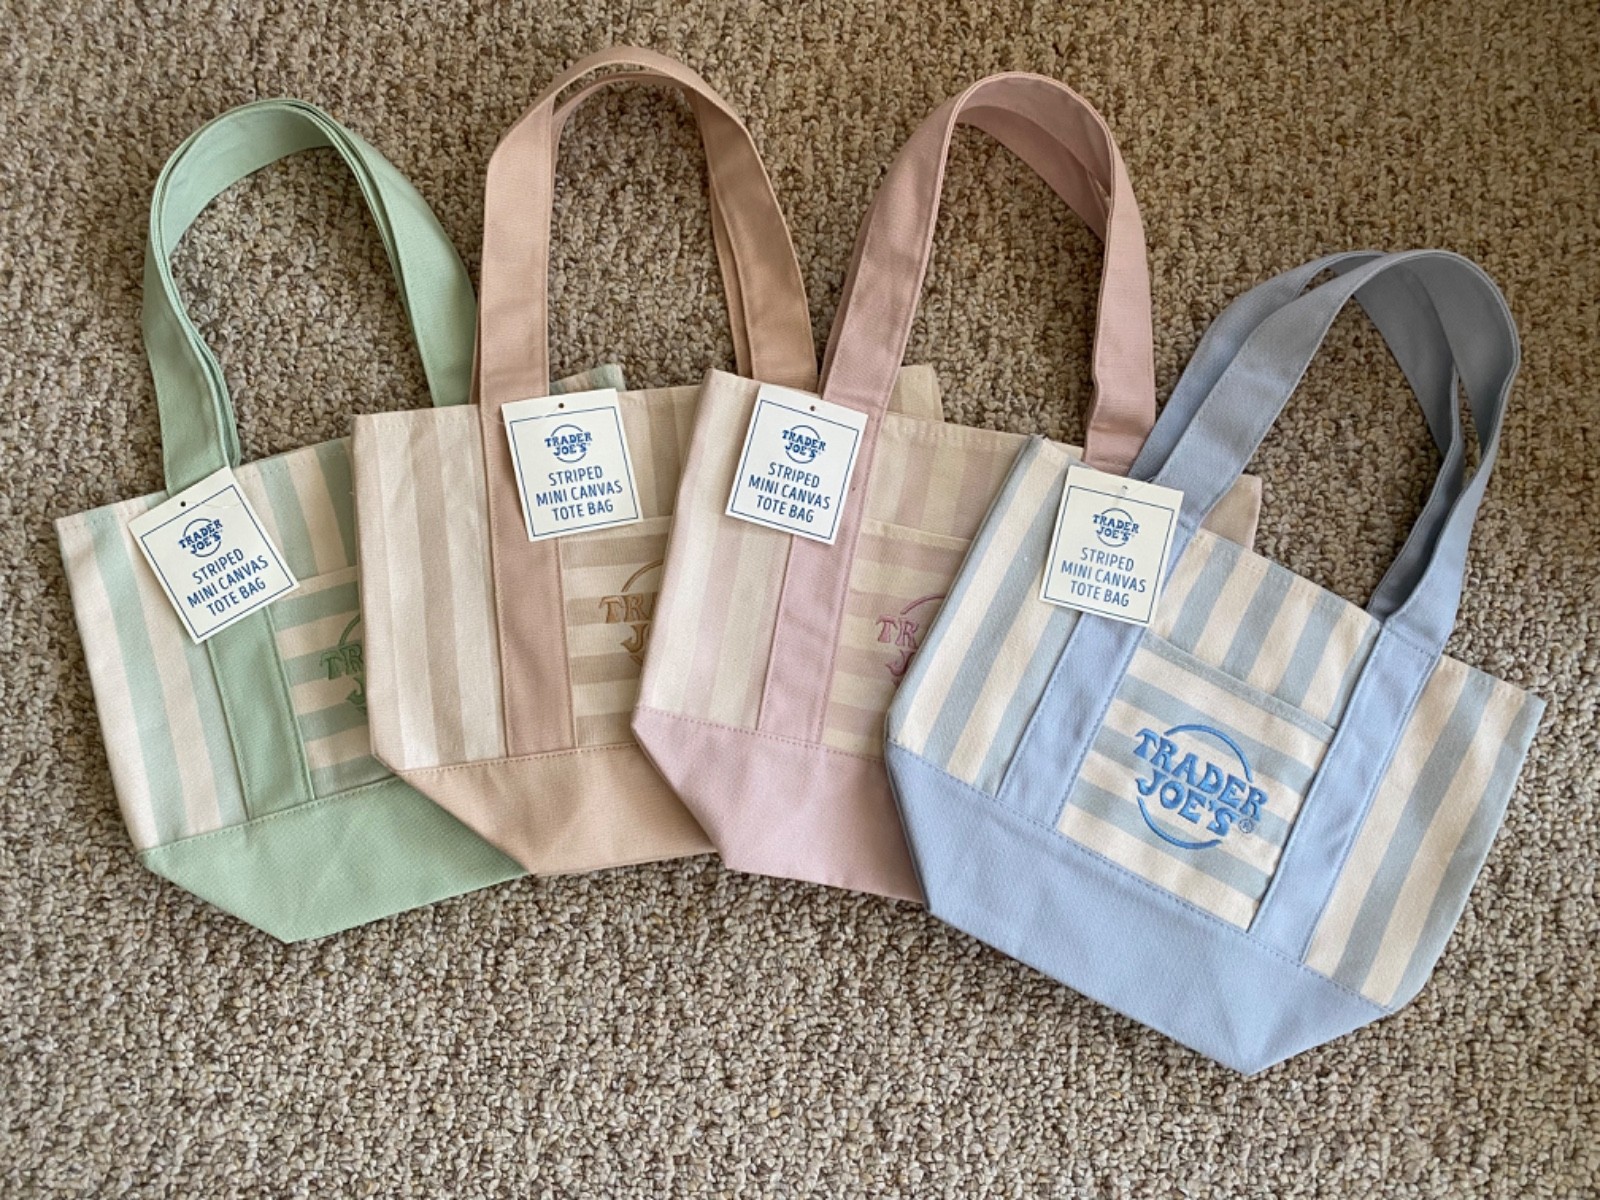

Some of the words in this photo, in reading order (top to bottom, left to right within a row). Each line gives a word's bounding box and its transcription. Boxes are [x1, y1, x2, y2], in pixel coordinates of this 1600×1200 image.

[544, 431, 592, 448] TRADER
[781, 429, 826, 451] TRADER
[548, 465, 603, 487] STRIPED
[768, 461, 820, 488] STRIPED
[535, 488, 568, 507] MINI
[571, 480, 623, 500] CANVAS
[748, 474, 779, 494] MINI
[781, 484, 831, 510] CANVAS
[551, 505, 585, 521] TOTE
[588, 499, 614, 515] BAG
[756, 495, 785, 515] TOTE
[788, 504, 814, 523] BAG
[178, 519, 223, 549] TRADER
[1092, 514, 1140, 534] TRADER
[192, 548, 244, 585] STRIPED
[1080, 547, 1134, 572] STRIPED
[186, 582, 219, 609] MINI
[218, 555, 269, 590] CANVAS
[1061, 560, 1092, 580] MINI
[1095, 569, 1147, 593] CANVAS
[206, 592, 239, 616] TOTE
[239, 577, 266, 600] BAG
[1070, 580, 1101, 600] TOTE
[1104, 589, 1130, 607] BAG
[1133, 728, 1269, 822] TRADER
